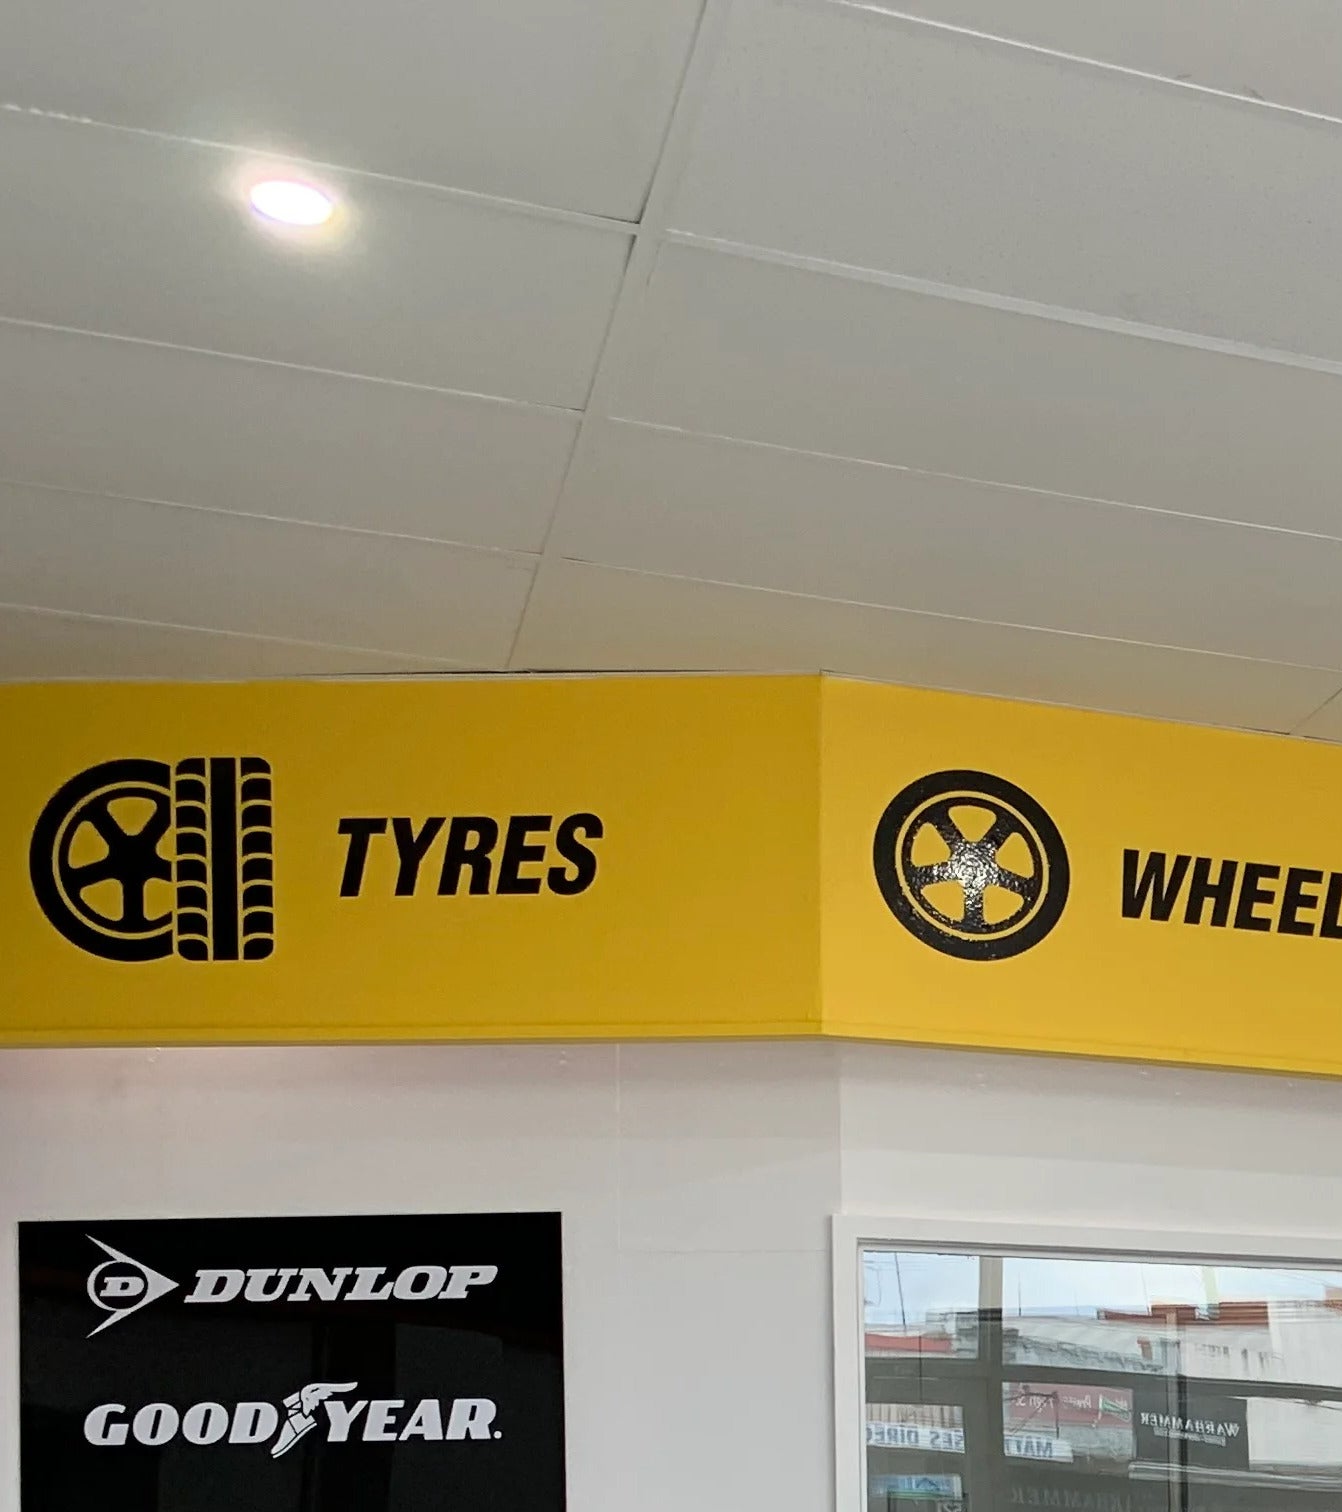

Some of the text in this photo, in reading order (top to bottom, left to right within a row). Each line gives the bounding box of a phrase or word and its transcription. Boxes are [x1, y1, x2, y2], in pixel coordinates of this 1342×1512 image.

[337, 812, 604, 898] TYRES
[99, 1276, 146, 1297] D
[183, 1265, 499, 1304] DUNLOP
